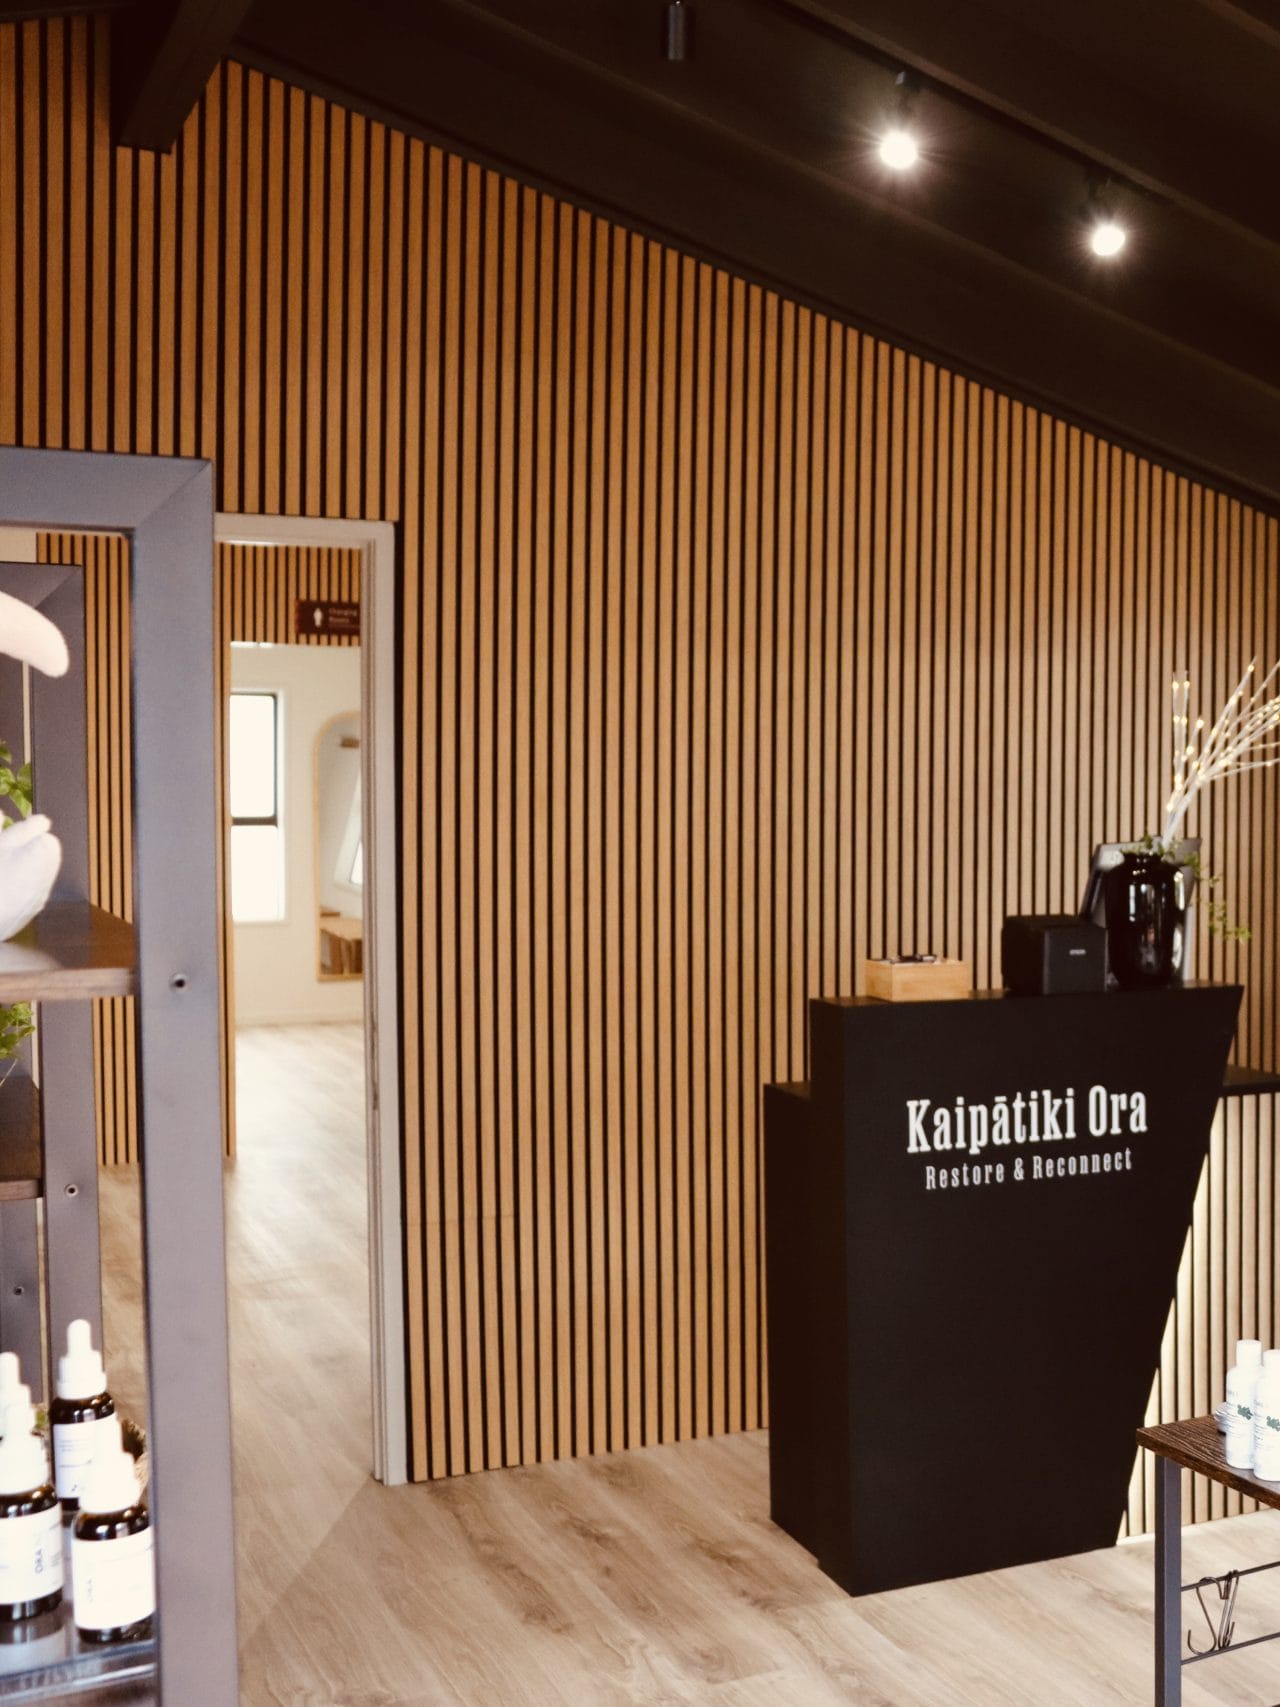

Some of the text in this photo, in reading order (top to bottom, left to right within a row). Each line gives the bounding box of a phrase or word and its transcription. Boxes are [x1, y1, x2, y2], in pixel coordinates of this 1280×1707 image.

[906, 1084, 1148, 1155] Kaipātiki Ora
[925, 1147, 1132, 1190] Restore & Reconnect
